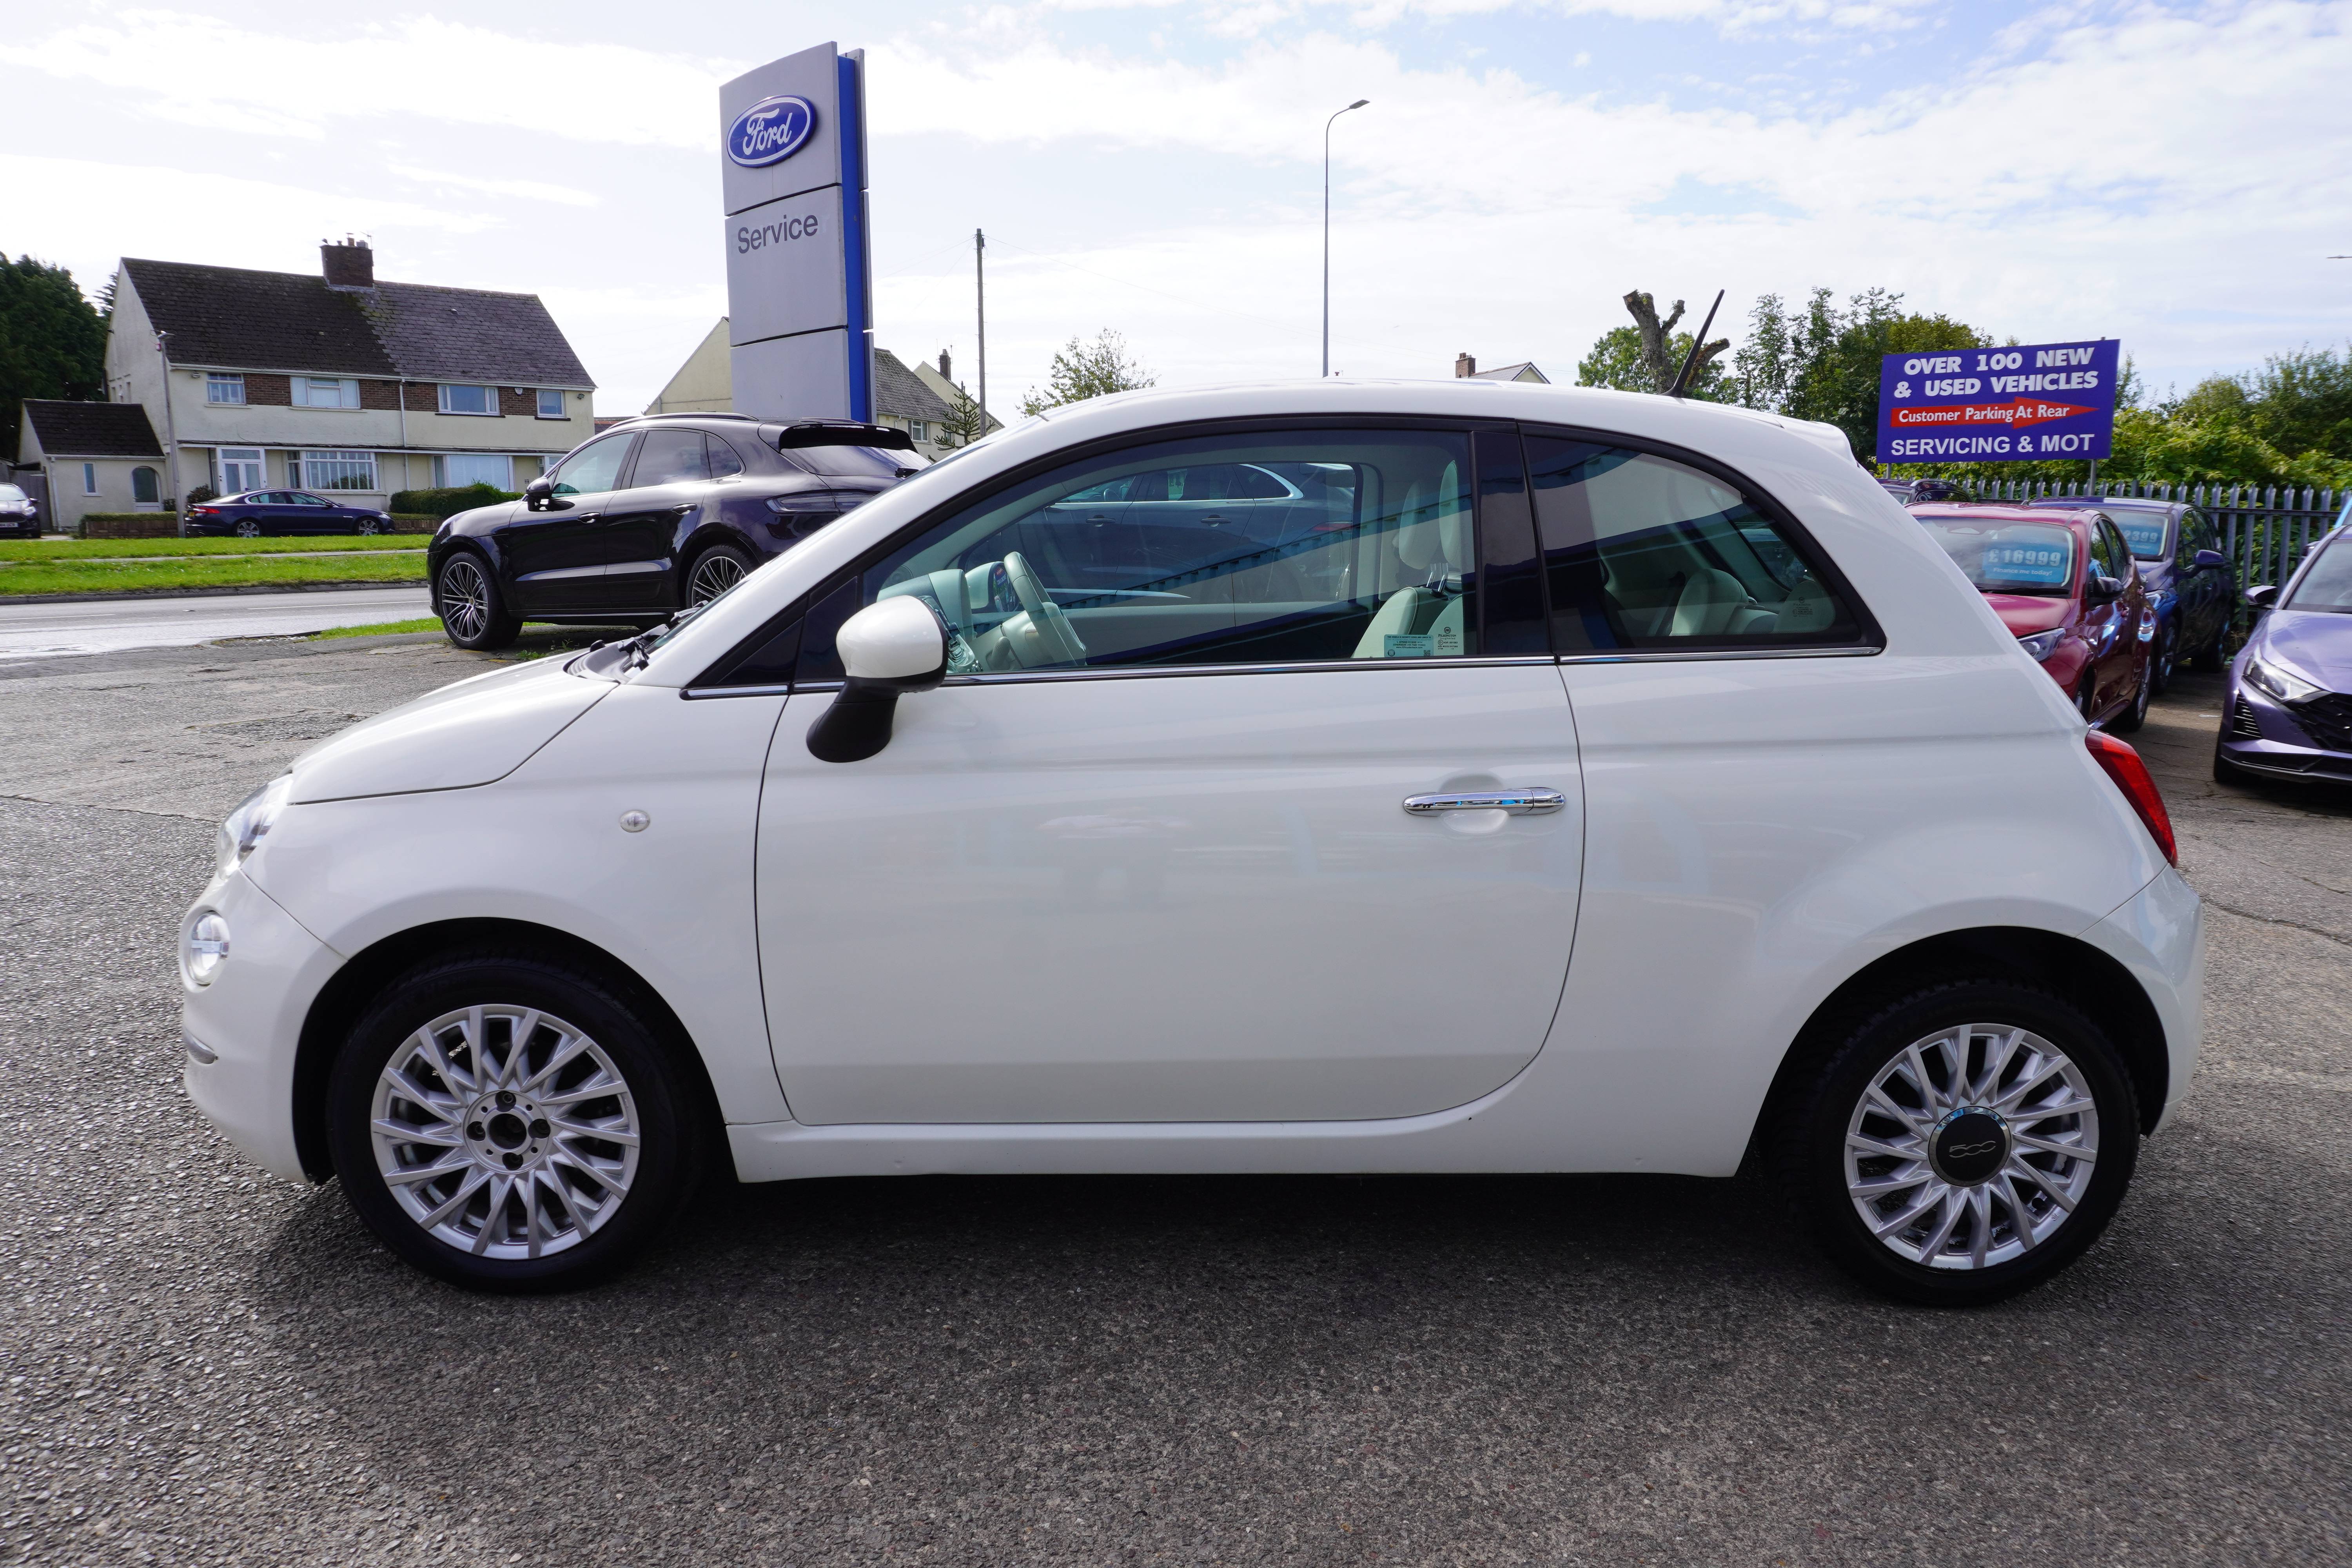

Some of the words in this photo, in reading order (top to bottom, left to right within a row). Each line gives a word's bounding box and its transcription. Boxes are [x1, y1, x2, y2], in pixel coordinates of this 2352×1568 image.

[742, 108, 793, 155] Ford
[738, 214, 818, 254] Service
[1904, 356, 1962, 375] OVER
[1976, 352, 2023, 371] 100
[2036, 347, 2095, 368] NEW
[1894, 381, 1912, 398] &
[1925, 378, 1981, 396] USED
[1990, 371, 2099, 393] VEHICLES
[1899, 410, 1960, 423] Customer
[1965, 407, 2013, 423] Parking
[2015, 406, 2033, 418] At
[2038, 405, 2070, 417] Rear
[1891, 436, 2011, 456] SERVICING
[2017, 436, 2034, 452] &
[2041, 434, 2095, 452] MOT
[2122, 530, 2158, 543] 2399
[2004, 549, 2061, 566] 16999
